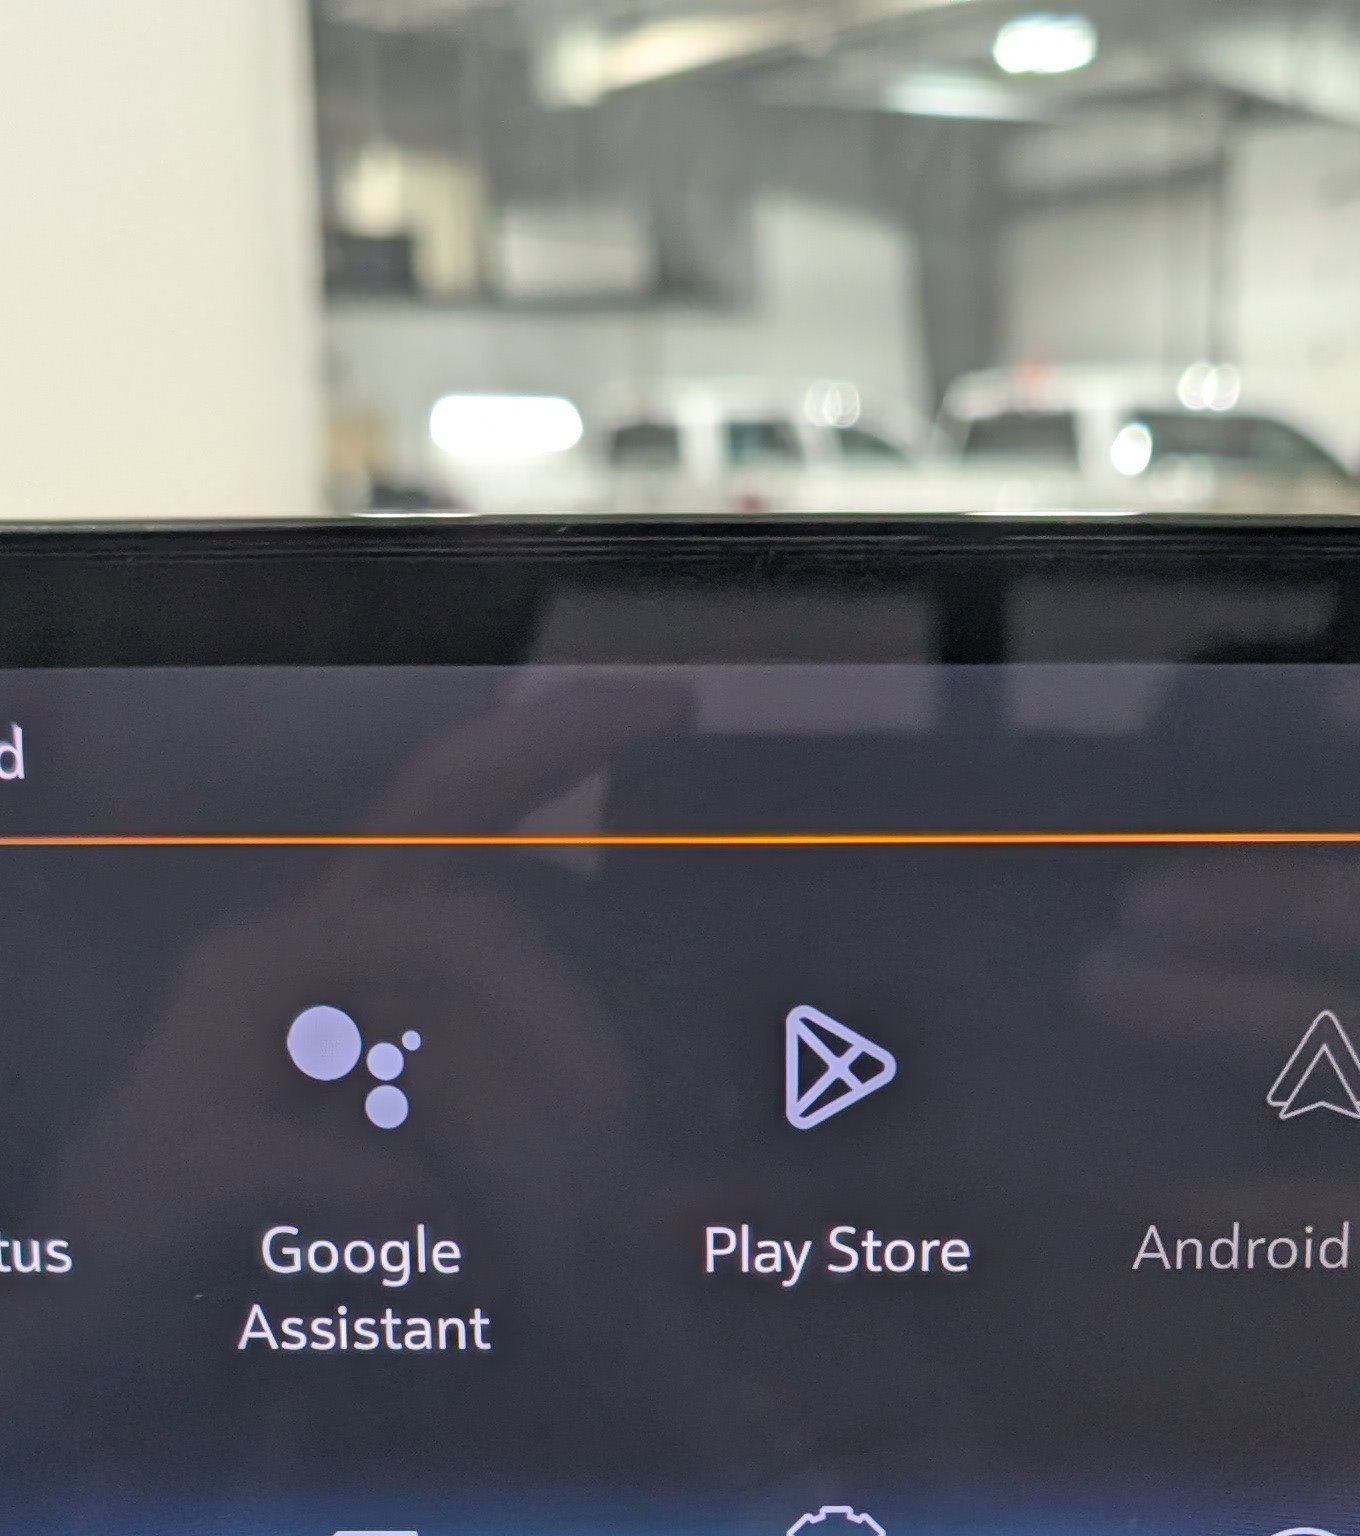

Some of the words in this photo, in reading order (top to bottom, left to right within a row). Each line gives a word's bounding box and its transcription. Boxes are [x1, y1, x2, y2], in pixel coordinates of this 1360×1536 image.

[261, 1223, 464, 1290] Google
[706, 1223, 814, 1290] Play
[827, 1225, 973, 1275] Store
[1131, 1220, 1352, 1272] Android
[237, 1304, 493, 1353] Assistant
